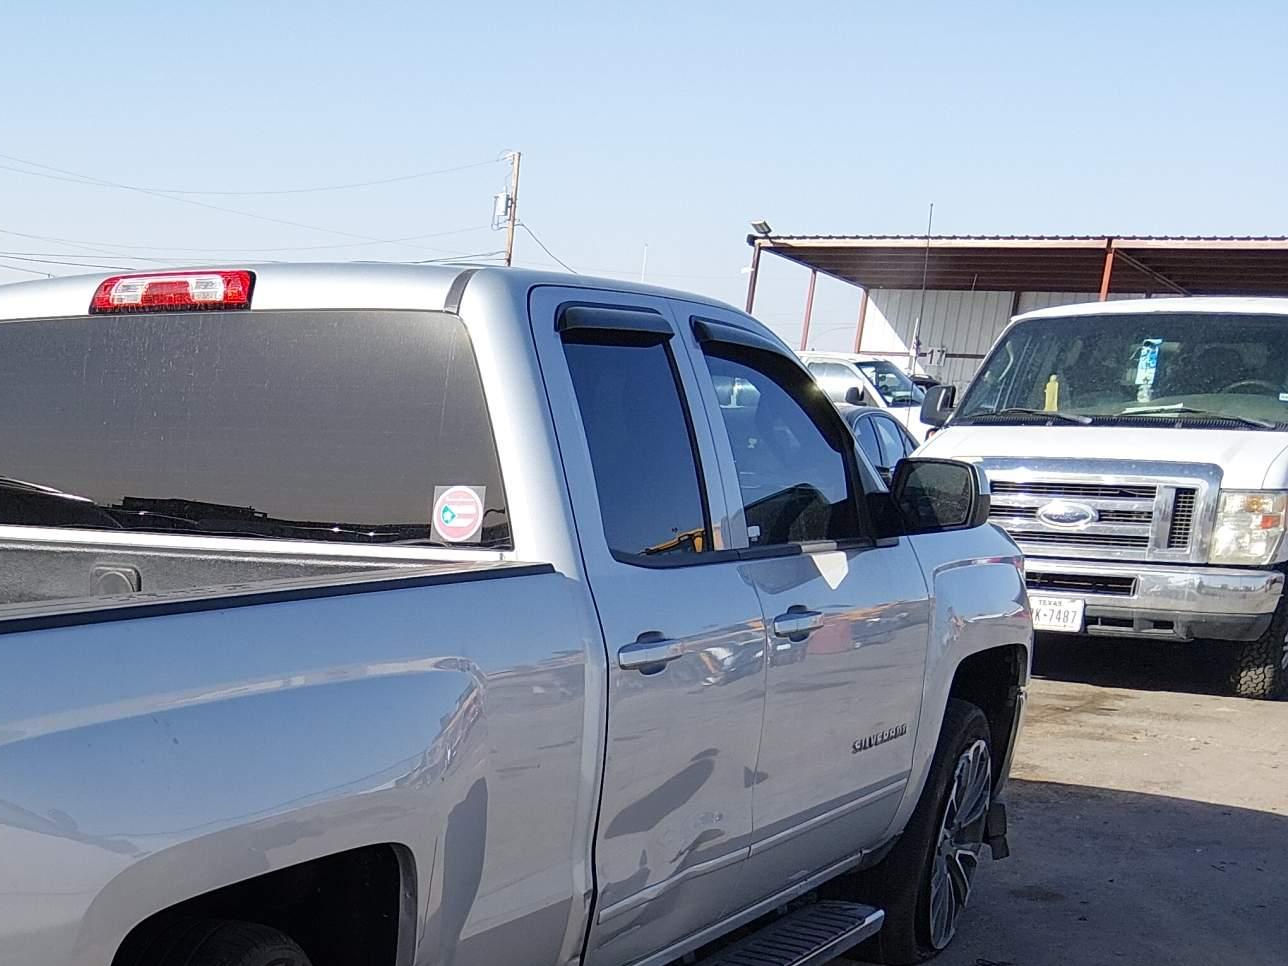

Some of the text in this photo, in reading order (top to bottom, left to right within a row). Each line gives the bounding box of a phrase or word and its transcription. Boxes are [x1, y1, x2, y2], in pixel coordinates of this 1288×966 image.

[927, 348, 946, 366] 17
[1038, 599, 1063, 607] TEXAS
[1032, 607, 1078, 624] K-7487
